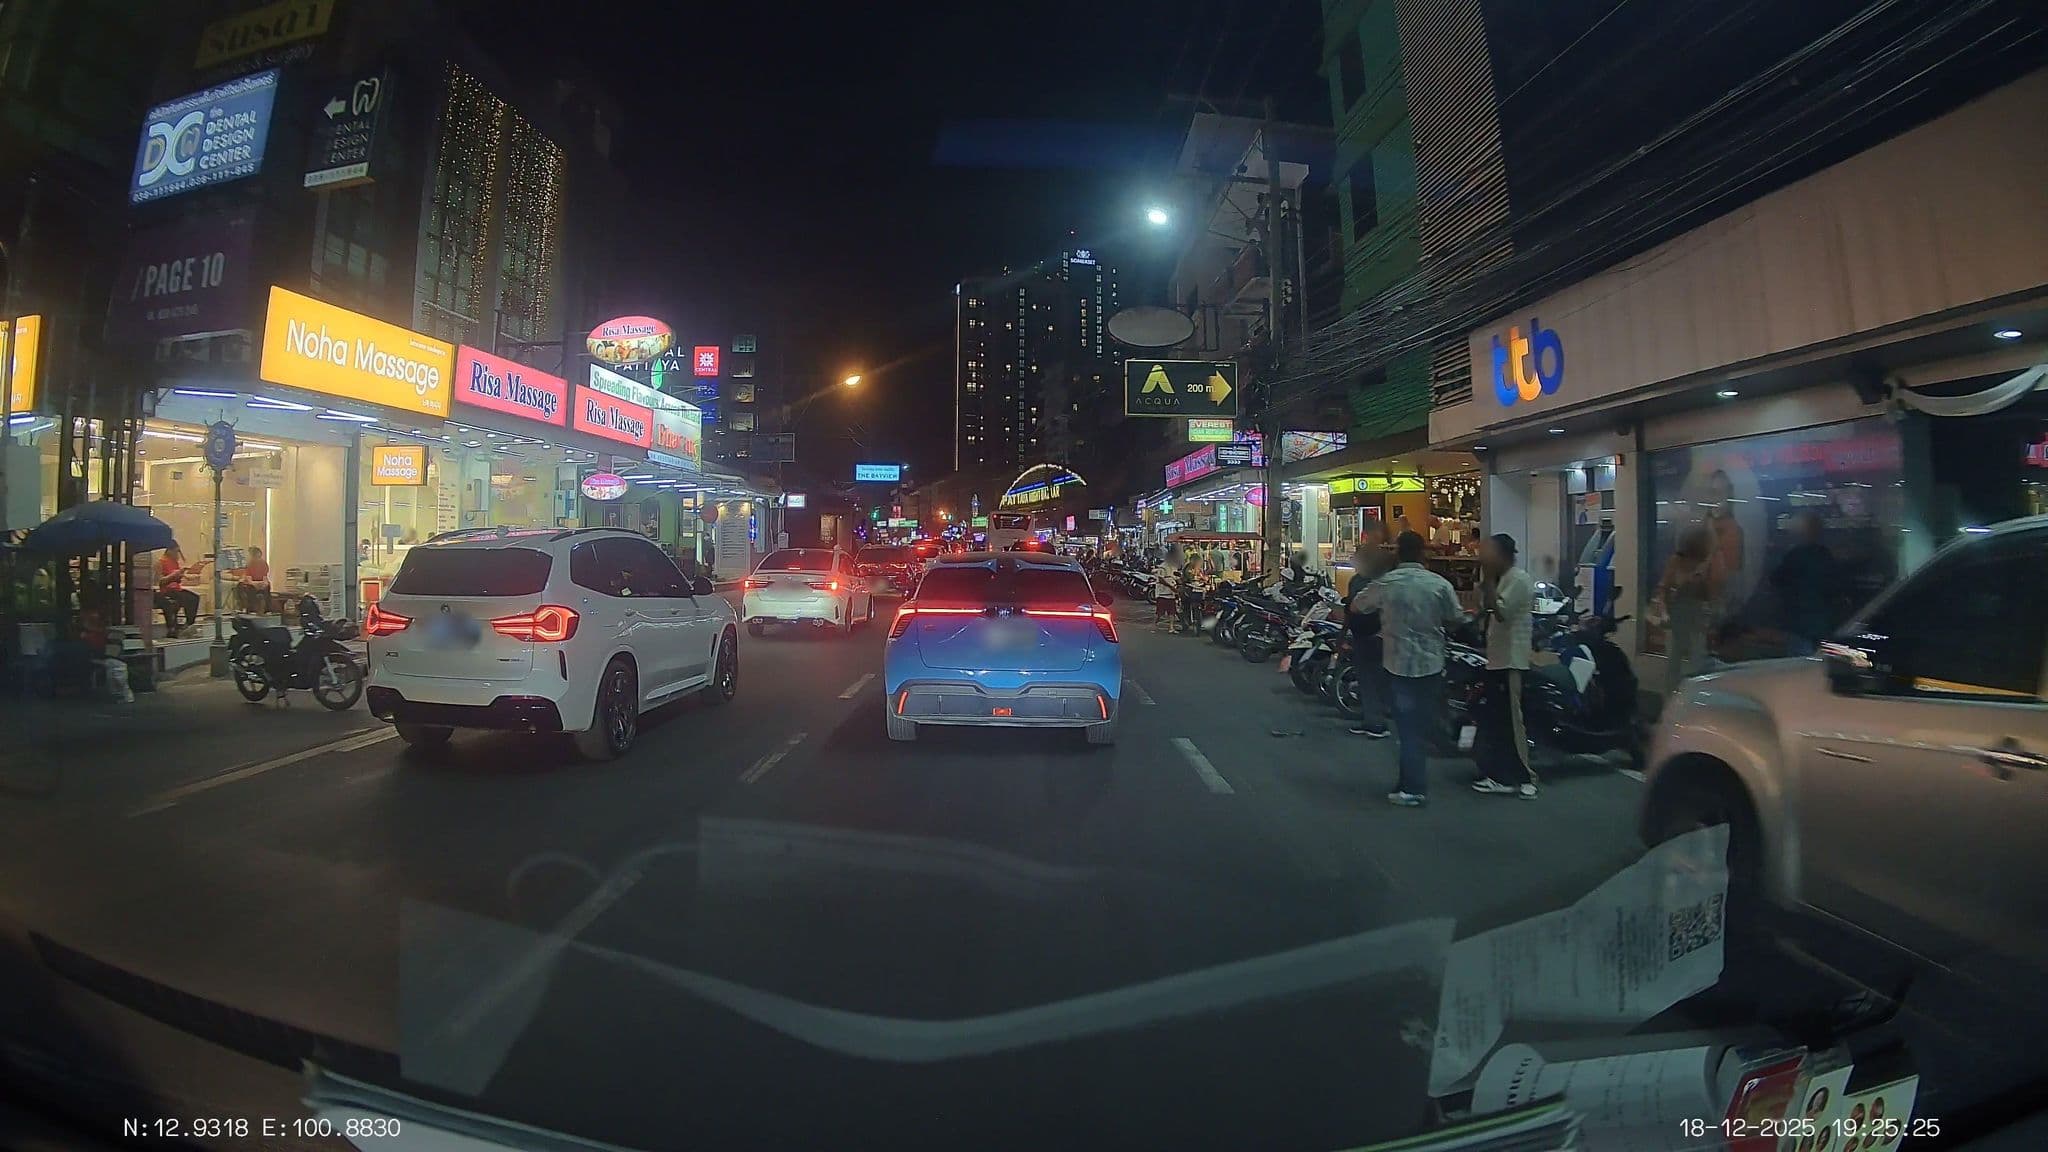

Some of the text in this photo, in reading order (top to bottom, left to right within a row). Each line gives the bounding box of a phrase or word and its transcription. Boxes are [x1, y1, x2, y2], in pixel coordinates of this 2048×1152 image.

[205, 110, 257, 135] DENTAL
[202, 127, 255, 153] DESIGN
[198, 145, 252, 170] CENTER
[201, 251, 225, 289] 10
[602, 323, 657, 337] Risa Massage
[286, 319, 440, 396] Noha Massage
[1491, 317, 1564, 407] ttb
[470, 359, 559, 419] Risa Massage
[594, 371, 631, 400] Spreading
[1187, 384, 1214, 393] 200 m
[1135, 397, 1180, 406] ACQUA
[586, 397, 609, 425] Risa
[608, 405, 646, 442] Massage
[383, 452, 412, 466] Noha
[376, 466, 418, 480] Massage
